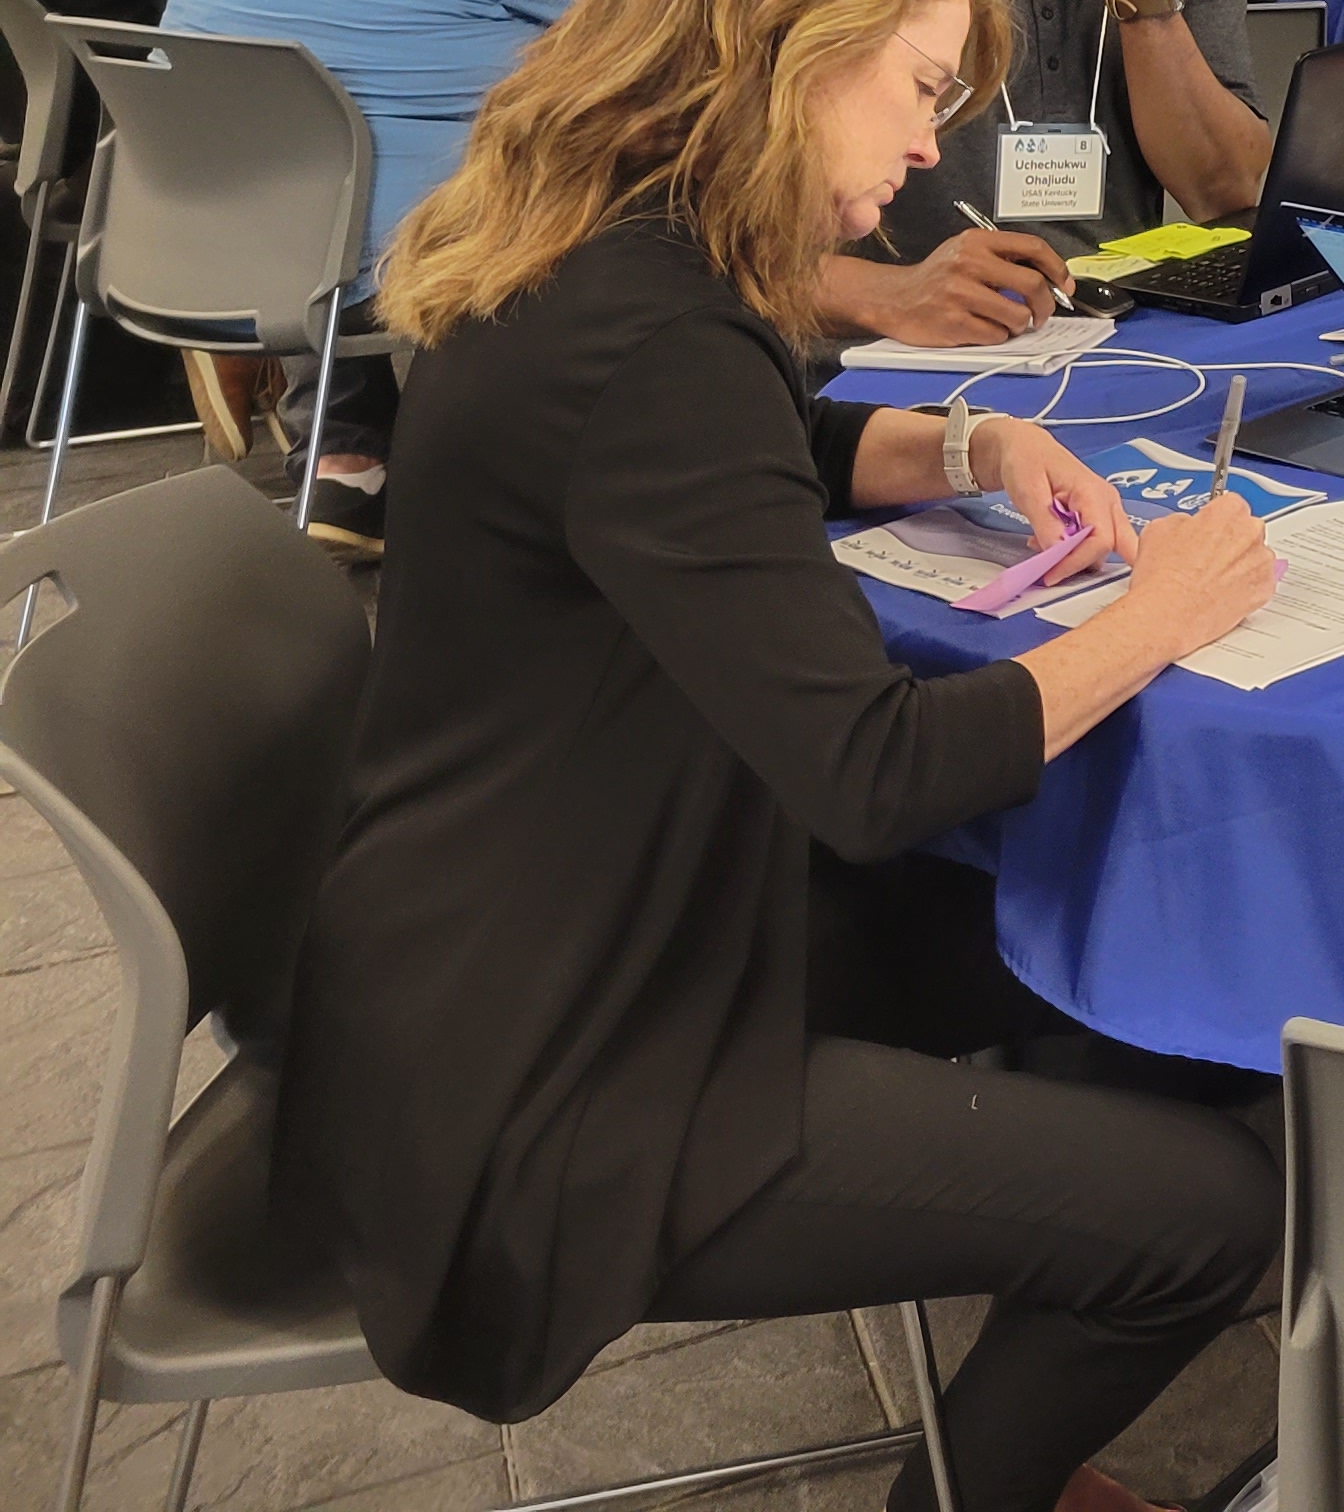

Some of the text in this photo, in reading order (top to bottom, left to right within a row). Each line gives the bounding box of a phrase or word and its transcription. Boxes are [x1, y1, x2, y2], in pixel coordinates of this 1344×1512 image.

[1015, 159, 1087, 170] Uchechukwu
[1025, 174, 1076, 187] Ohajiudu
[1044, 189, 1077, 198] Kentucky
[1021, 200, 1077, 208] State University
